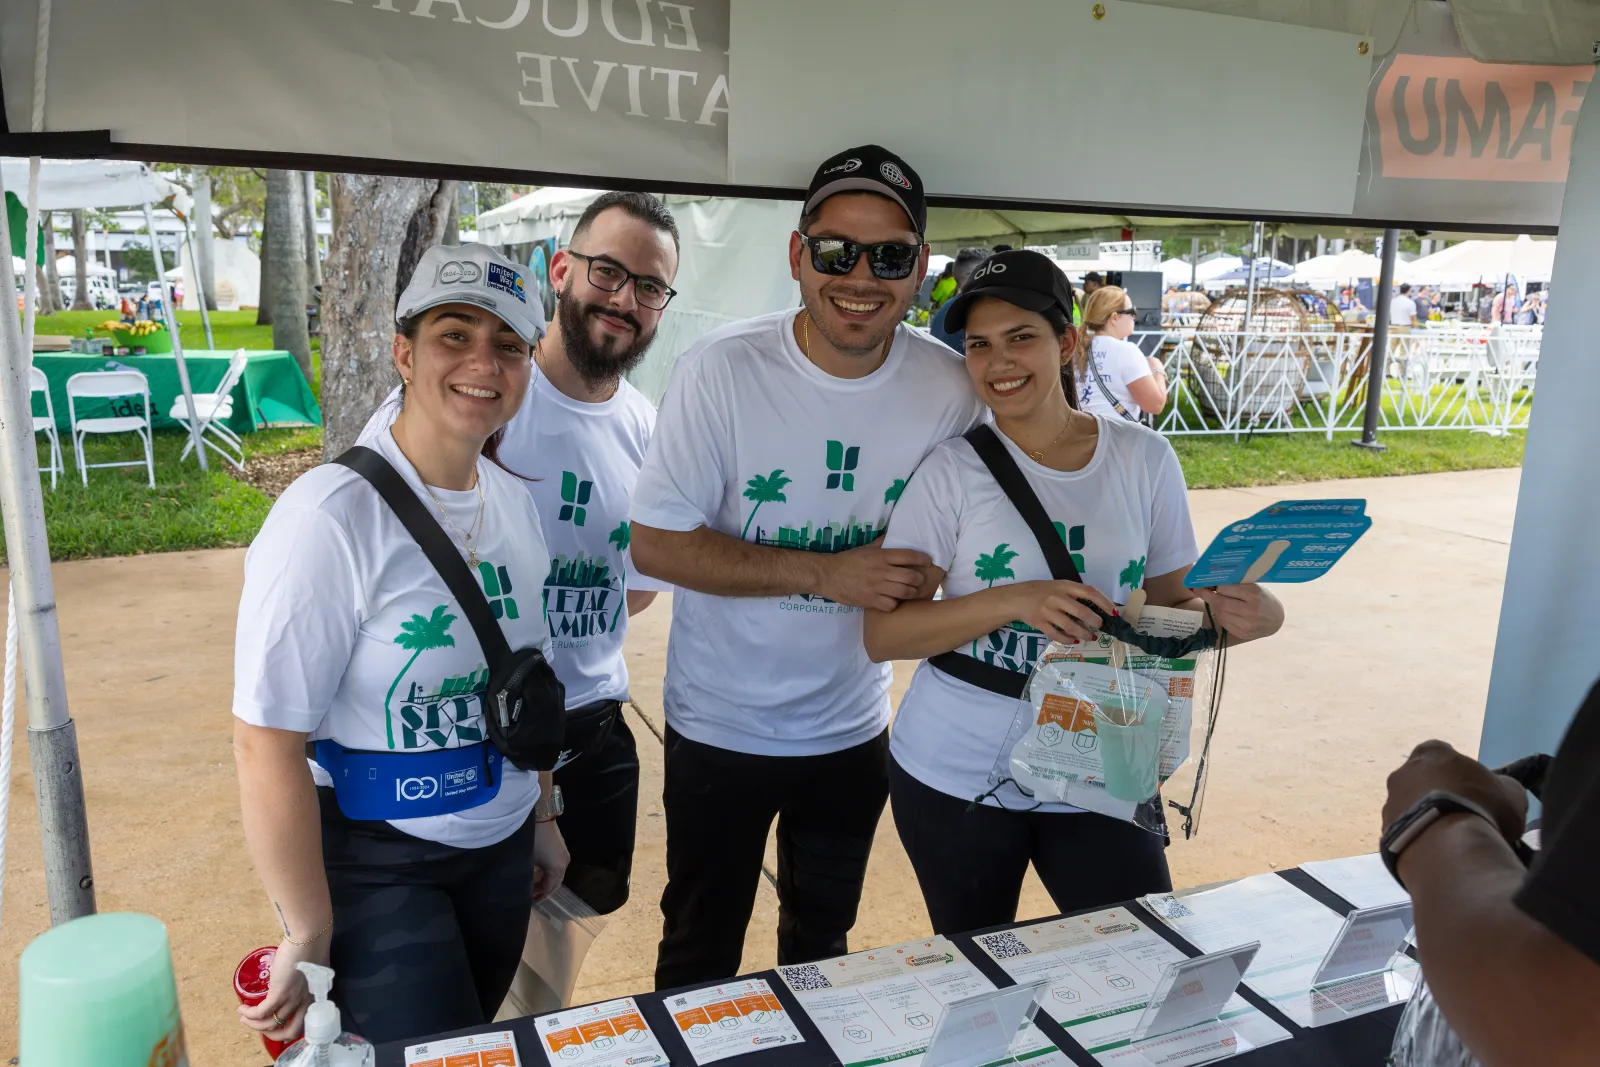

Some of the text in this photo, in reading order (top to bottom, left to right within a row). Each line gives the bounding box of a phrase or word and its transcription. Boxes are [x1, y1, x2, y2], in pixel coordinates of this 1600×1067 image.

[442, 269, 476, 278] 1924-2024
[490, 264, 514, 279] United
[973, 259, 1007, 280] alo
[486, 281, 505, 292] United
[500, 274, 513, 288] Way
[1326, 544, 1346, 552] off
[780, 602, 834, 614] CORPORATE
[837, 605, 854, 613] RUN
[557, 641, 574, 649] RUN
[402, 720, 489, 749] DYN
[446, 771, 465, 780] United
[396, 776, 438, 801] 100
[444, 789, 459, 797] United
